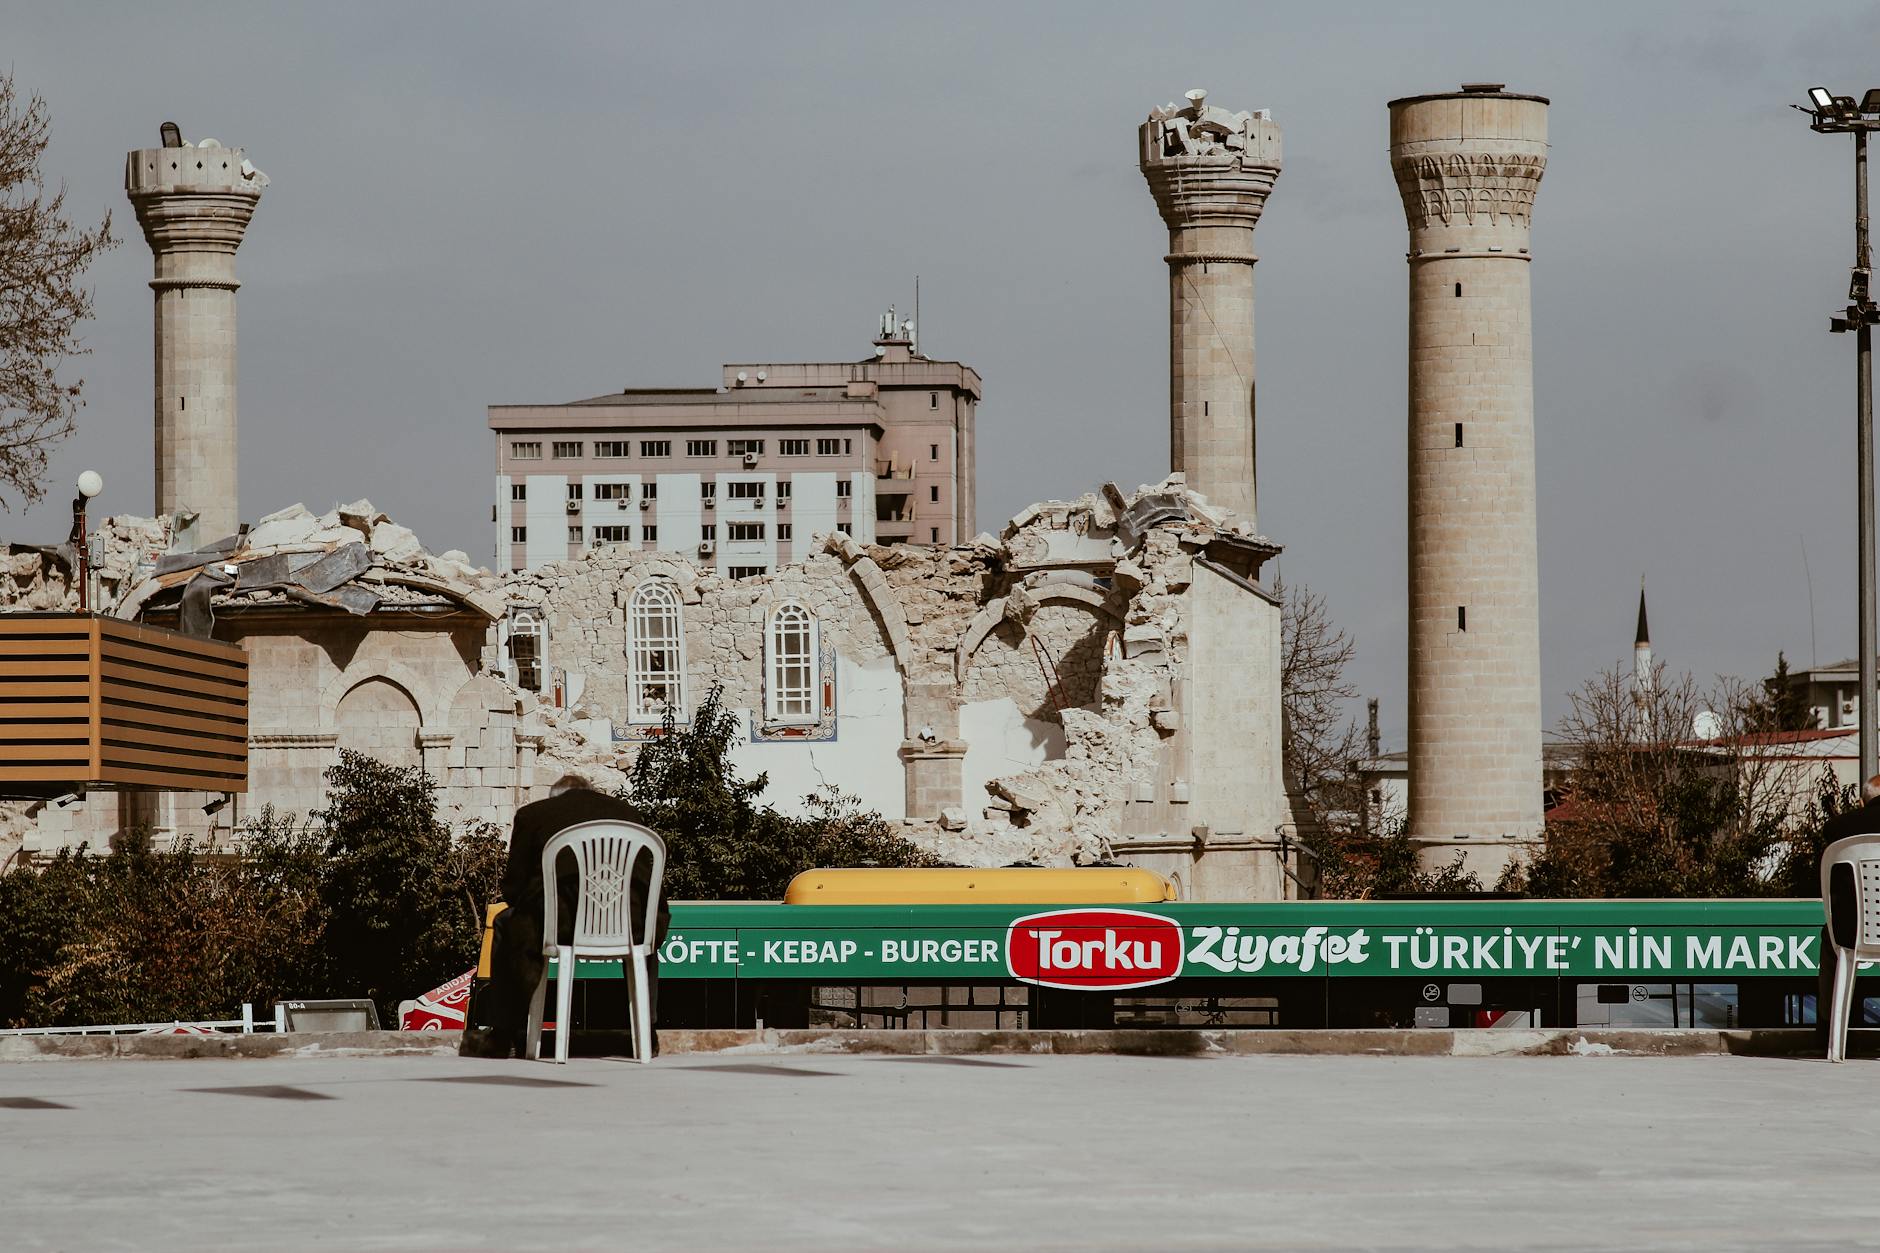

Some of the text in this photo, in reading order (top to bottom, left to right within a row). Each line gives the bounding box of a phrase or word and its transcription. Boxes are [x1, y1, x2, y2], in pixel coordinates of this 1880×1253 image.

[765, 940, 857, 964] KEBAP
[882, 940, 999, 964] BURGER
[1029, 928, 1162, 970] Torku
[1186, 926, 1370, 973] Ziyafet
[1596, 926, 1672, 969] NİN
[1687, 935, 1821, 969] MARK
